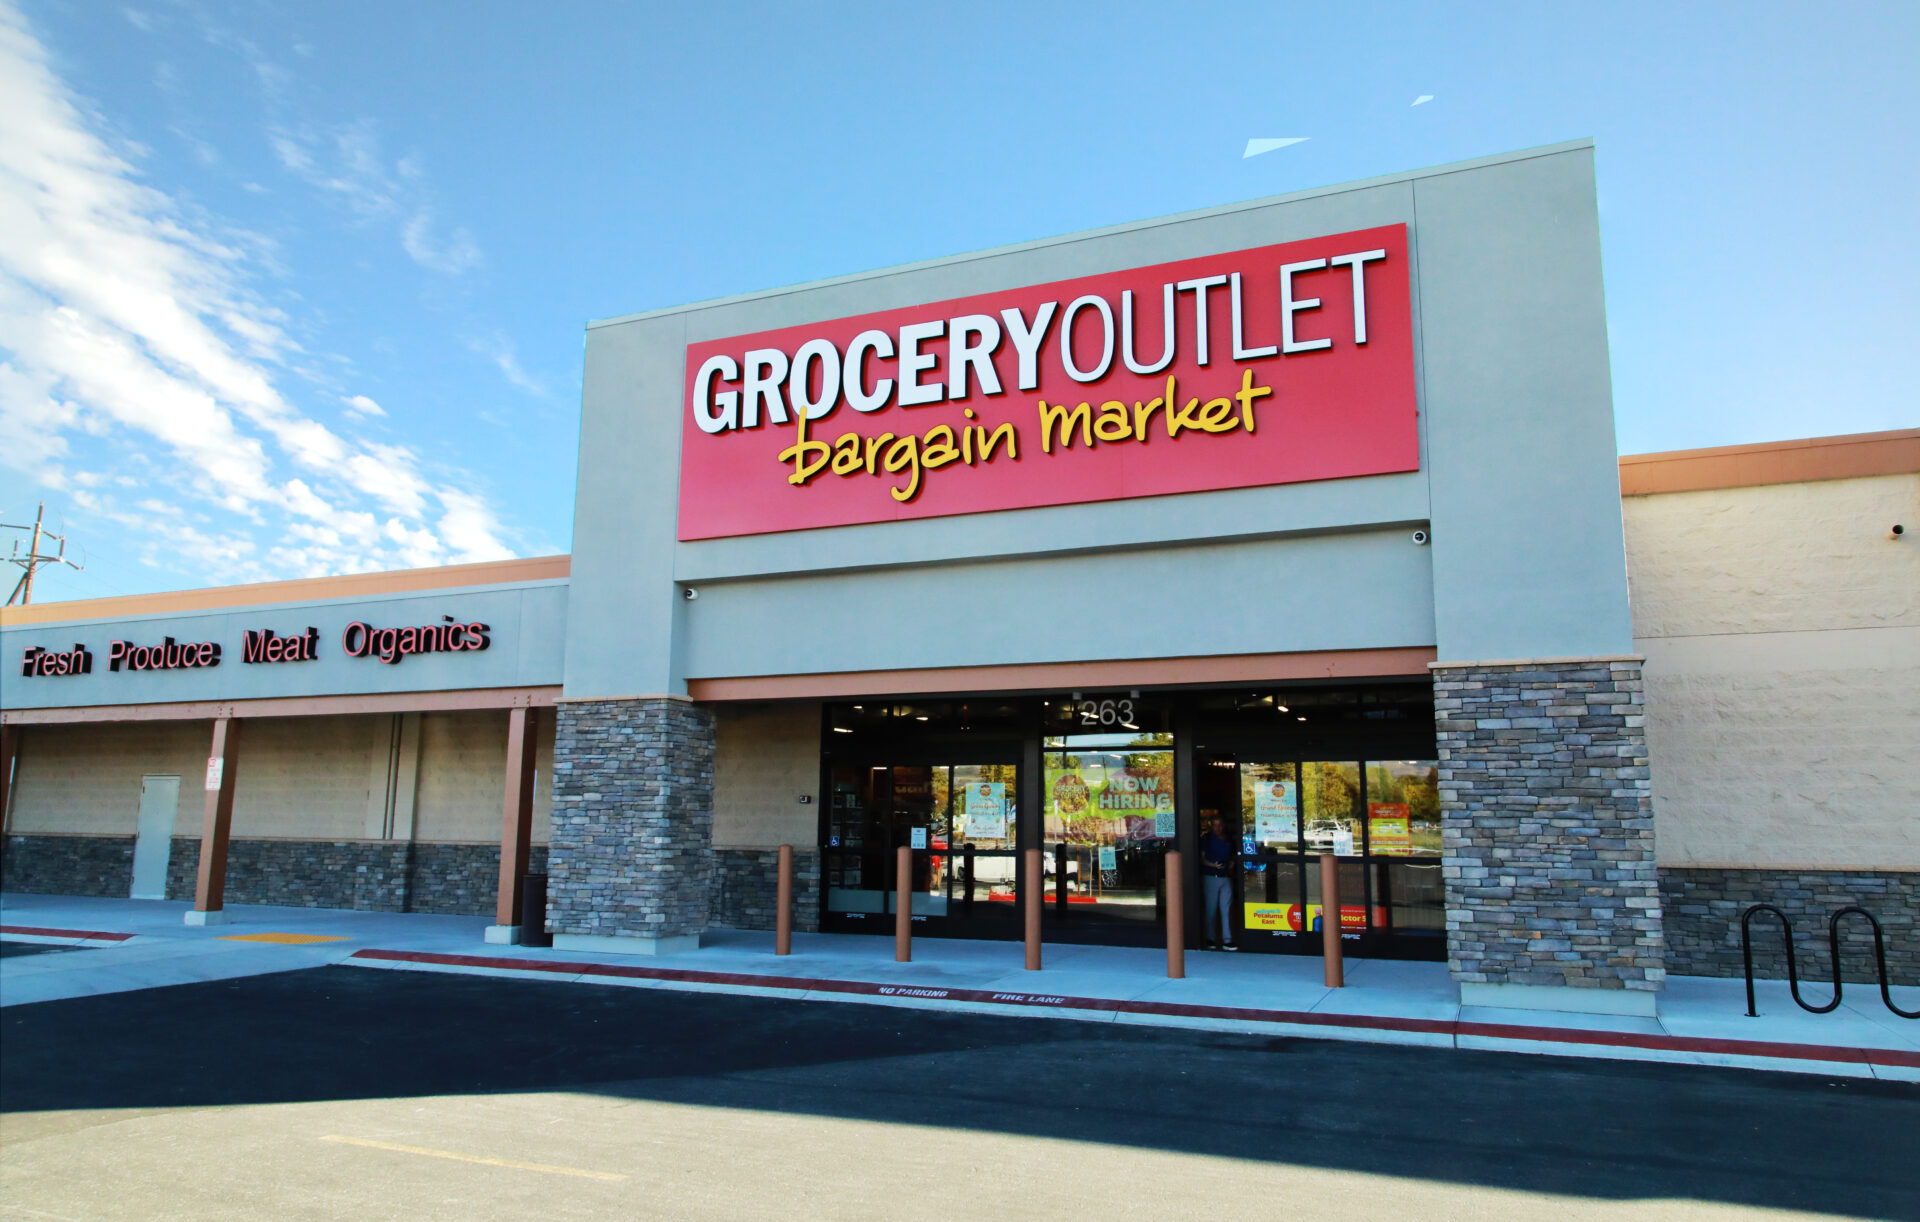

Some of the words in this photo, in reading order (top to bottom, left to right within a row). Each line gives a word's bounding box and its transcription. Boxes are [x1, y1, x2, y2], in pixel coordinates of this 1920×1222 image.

[778, 406, 1018, 501] bargain
[1039, 369, 1273, 454] market
[20, 643, 92, 677] Fresh
[107, 636, 222, 672] Produce
[241, 626, 319, 664] Meat
[343, 615, 491, 664] Organics
[1081, 699, 1135, 726] 263
[1108, 777, 1160, 792] NOW
[1099, 793, 1171, 809] HIRING
[1341, 914, 1361, 922] ictor
[896, 988, 949, 997] PARKING
[992, 993, 1024, 1001] FIRE
[1028, 996, 1066, 1004] LANE
